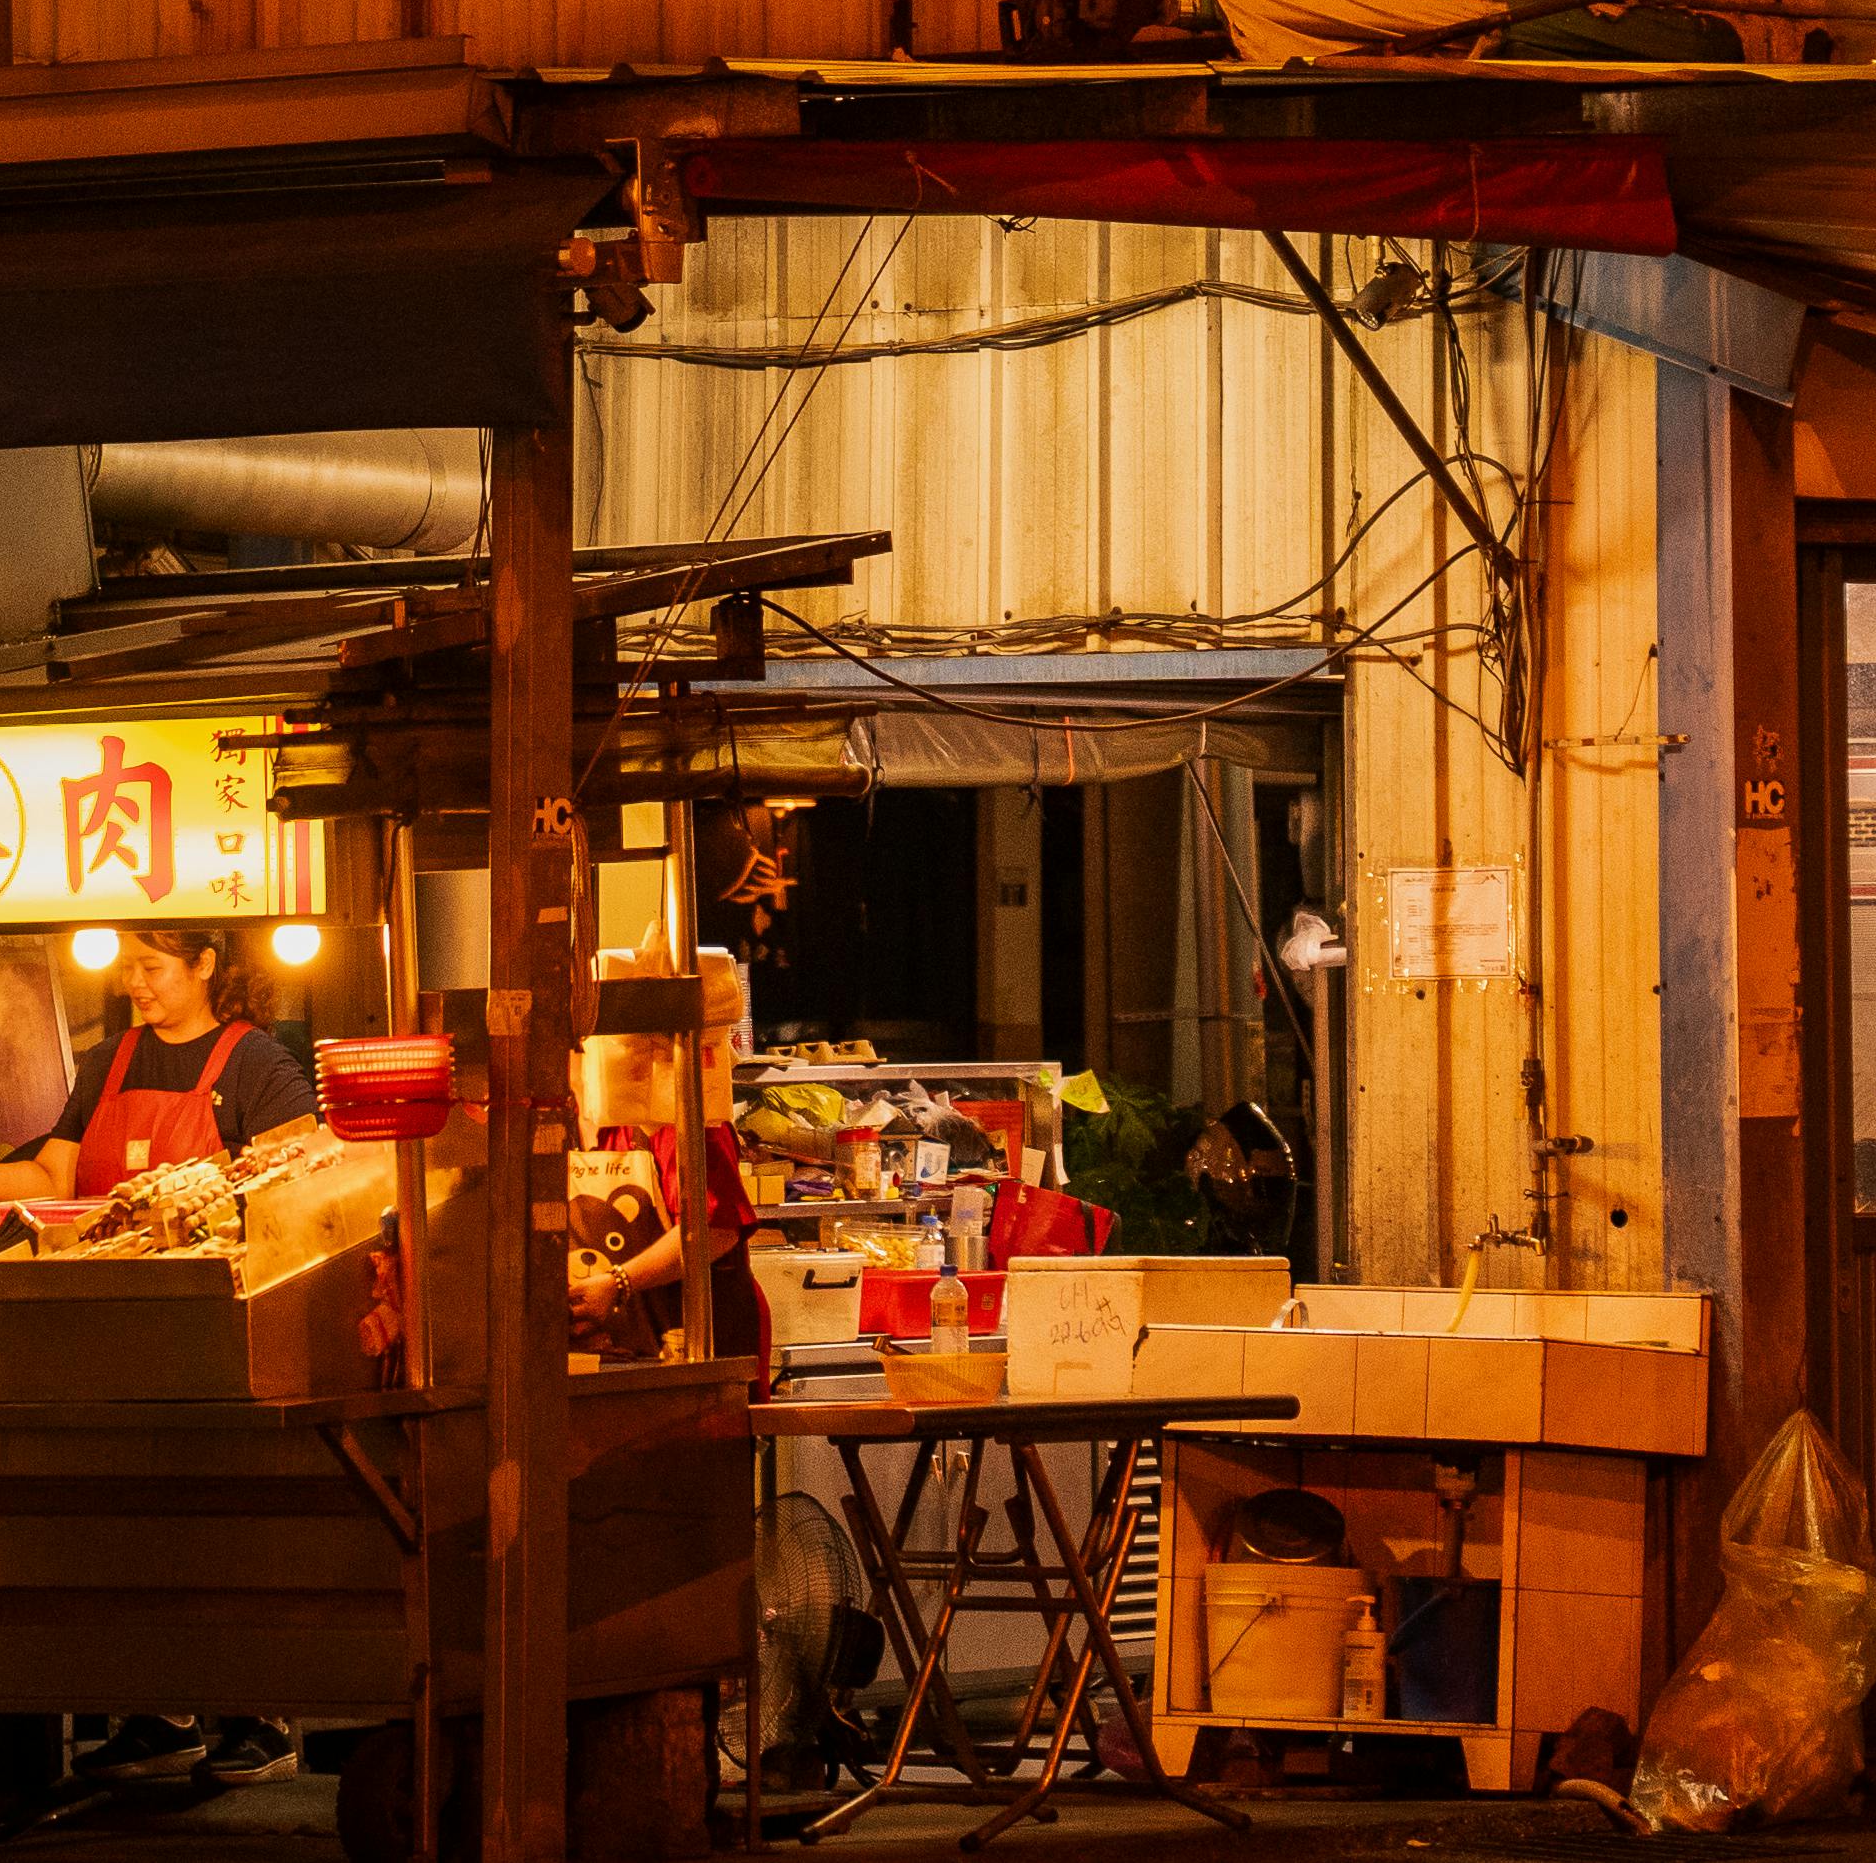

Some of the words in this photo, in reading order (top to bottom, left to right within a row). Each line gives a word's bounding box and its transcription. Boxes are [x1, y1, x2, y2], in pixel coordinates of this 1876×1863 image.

[1744, 779, 1786, 815] HC
[210, 727, 254, 911] 獨家口味
[604, 1161, 631, 1177] life
